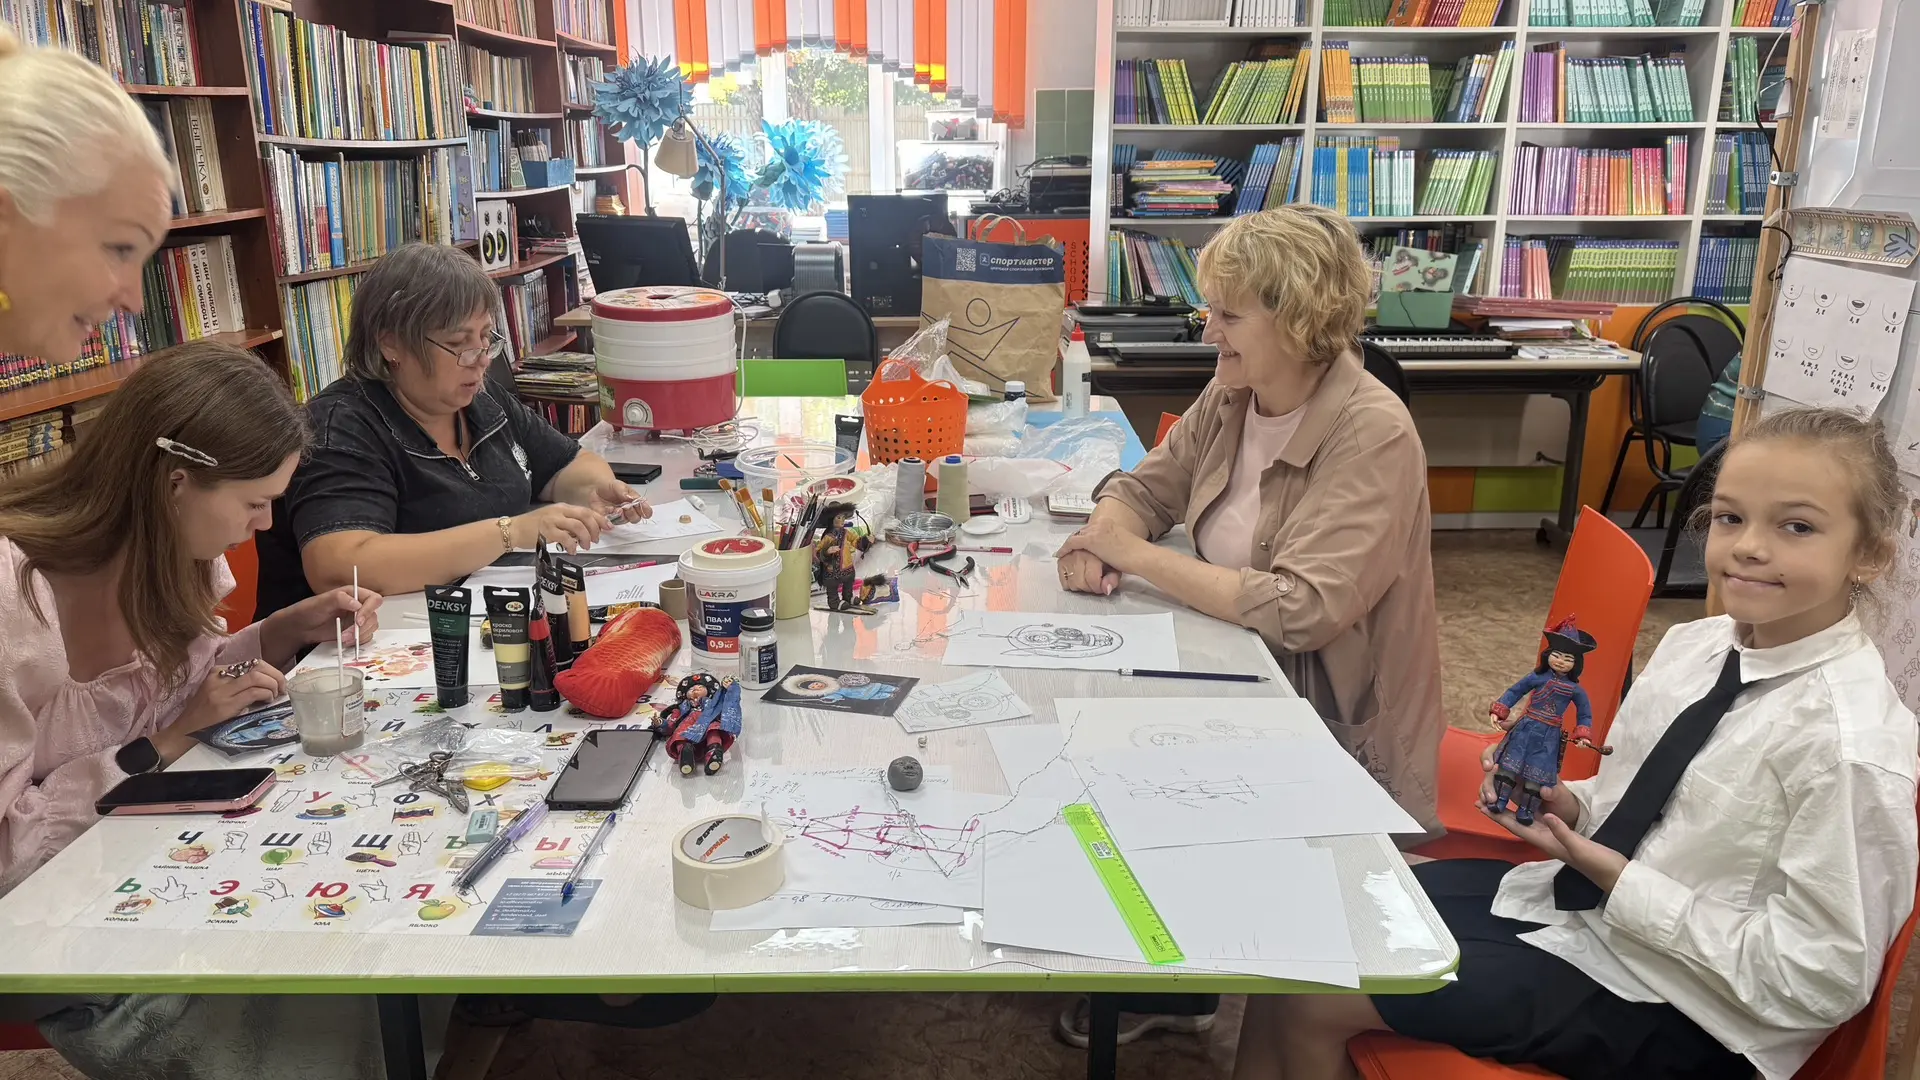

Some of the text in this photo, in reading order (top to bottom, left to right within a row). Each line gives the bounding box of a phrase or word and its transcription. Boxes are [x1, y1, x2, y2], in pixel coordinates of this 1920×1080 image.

[192, 120, 207, 182] ВЫПЕЧКА
[990, 257, 1054, 266] спортмастер
[197, 284, 208, 320] ПОЗНАЮ
[206, 282, 216, 318] ПОЗНАЮ
[393, 793, 420, 805] Ф
[178, 831, 204, 844] Ч
[260, 833, 304, 846] Ш
[352, 834, 394, 850] Щ
[535, 837, 572, 851] Ы
[114, 878, 142, 893] Ь
[210, 880, 240, 895] Э
[305, 882, 348, 898] Ю
[403, 882, 435, 899] Я
